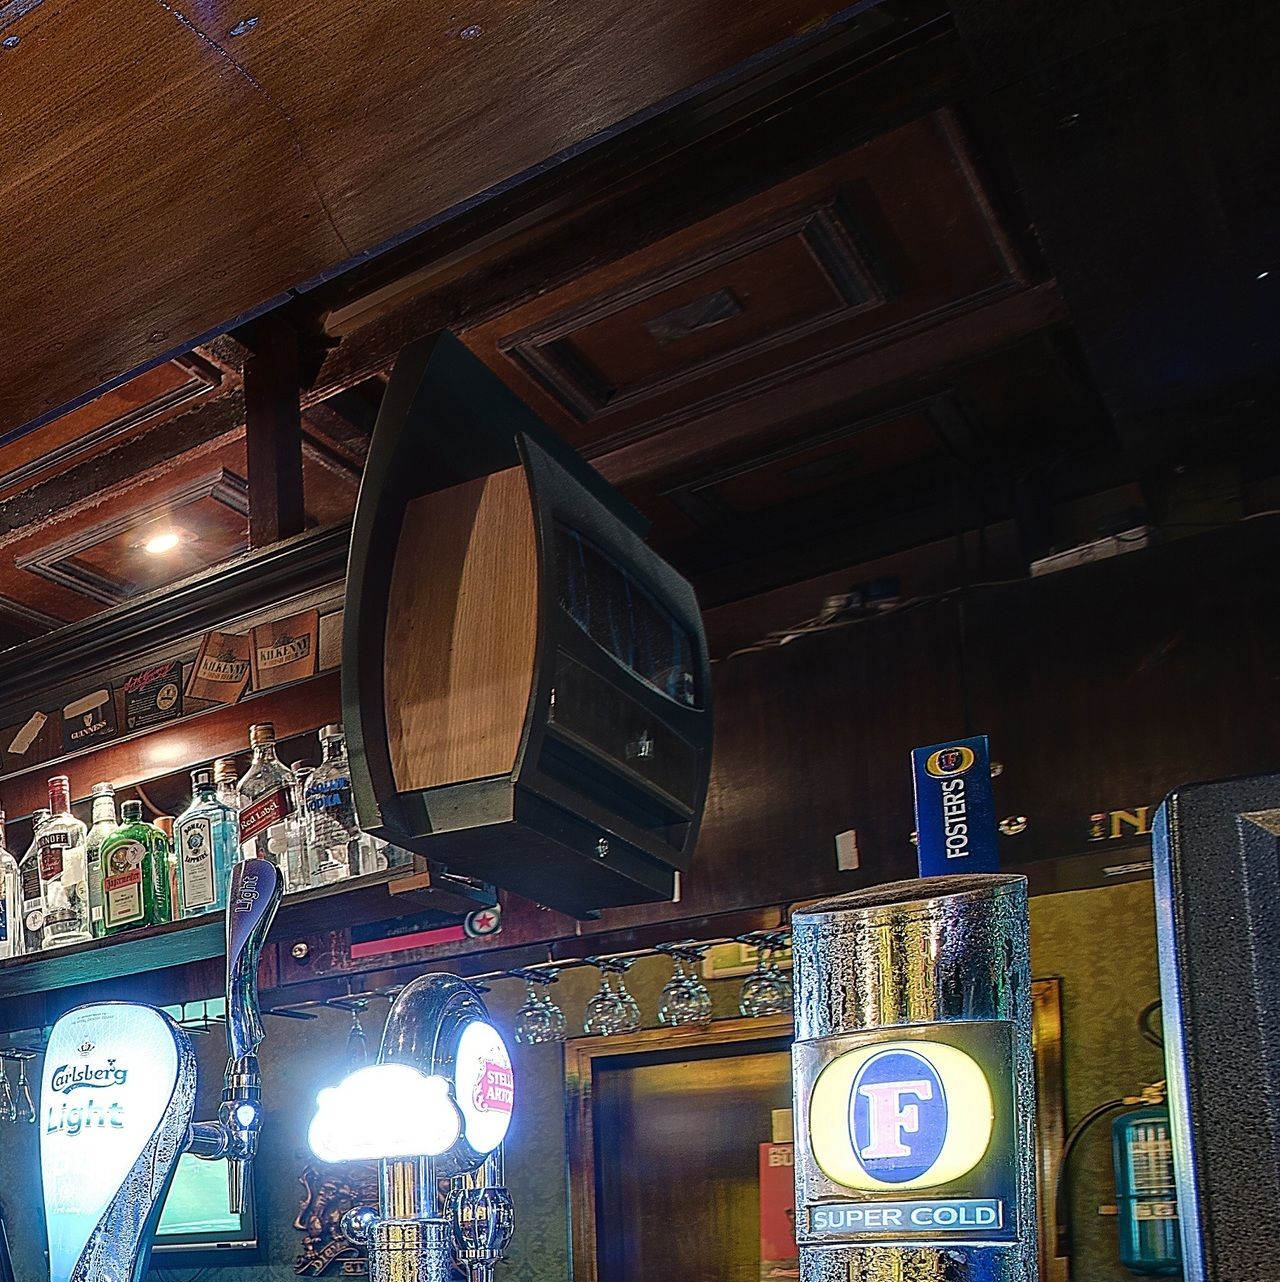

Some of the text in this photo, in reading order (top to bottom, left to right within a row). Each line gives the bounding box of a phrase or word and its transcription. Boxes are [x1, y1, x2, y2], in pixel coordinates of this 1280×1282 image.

[70, 719, 107, 740] GUINNESS
[241, 816, 256, 829] Red
[256, 801, 280, 819] Label
[942, 778, 969, 859] FOSTER'S
[235, 876, 260, 913] Light
[51, 1062, 128, 1093] Carlsberg
[486, 1070, 512, 1086] STELL
[46, 1100, 125, 1136] Light
[858, 1080, 933, 1160] F
[814, 1206, 996, 1229] SUPER COLD
